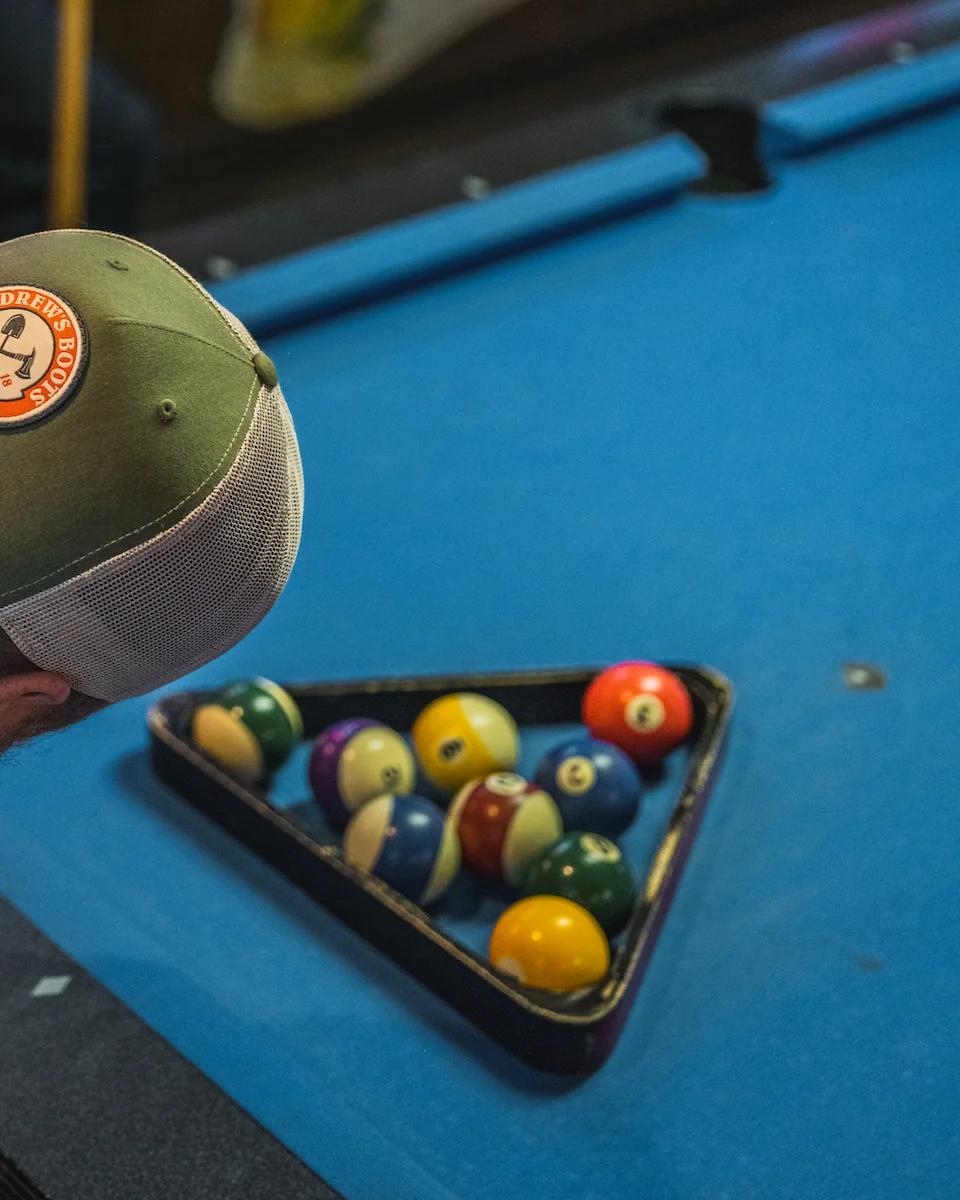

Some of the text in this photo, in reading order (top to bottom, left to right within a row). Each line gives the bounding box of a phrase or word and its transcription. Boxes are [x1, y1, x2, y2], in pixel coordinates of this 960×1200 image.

[0, 291, 75, 406] DREW'S BOOTS
[0, 373, 13, 387] 18
